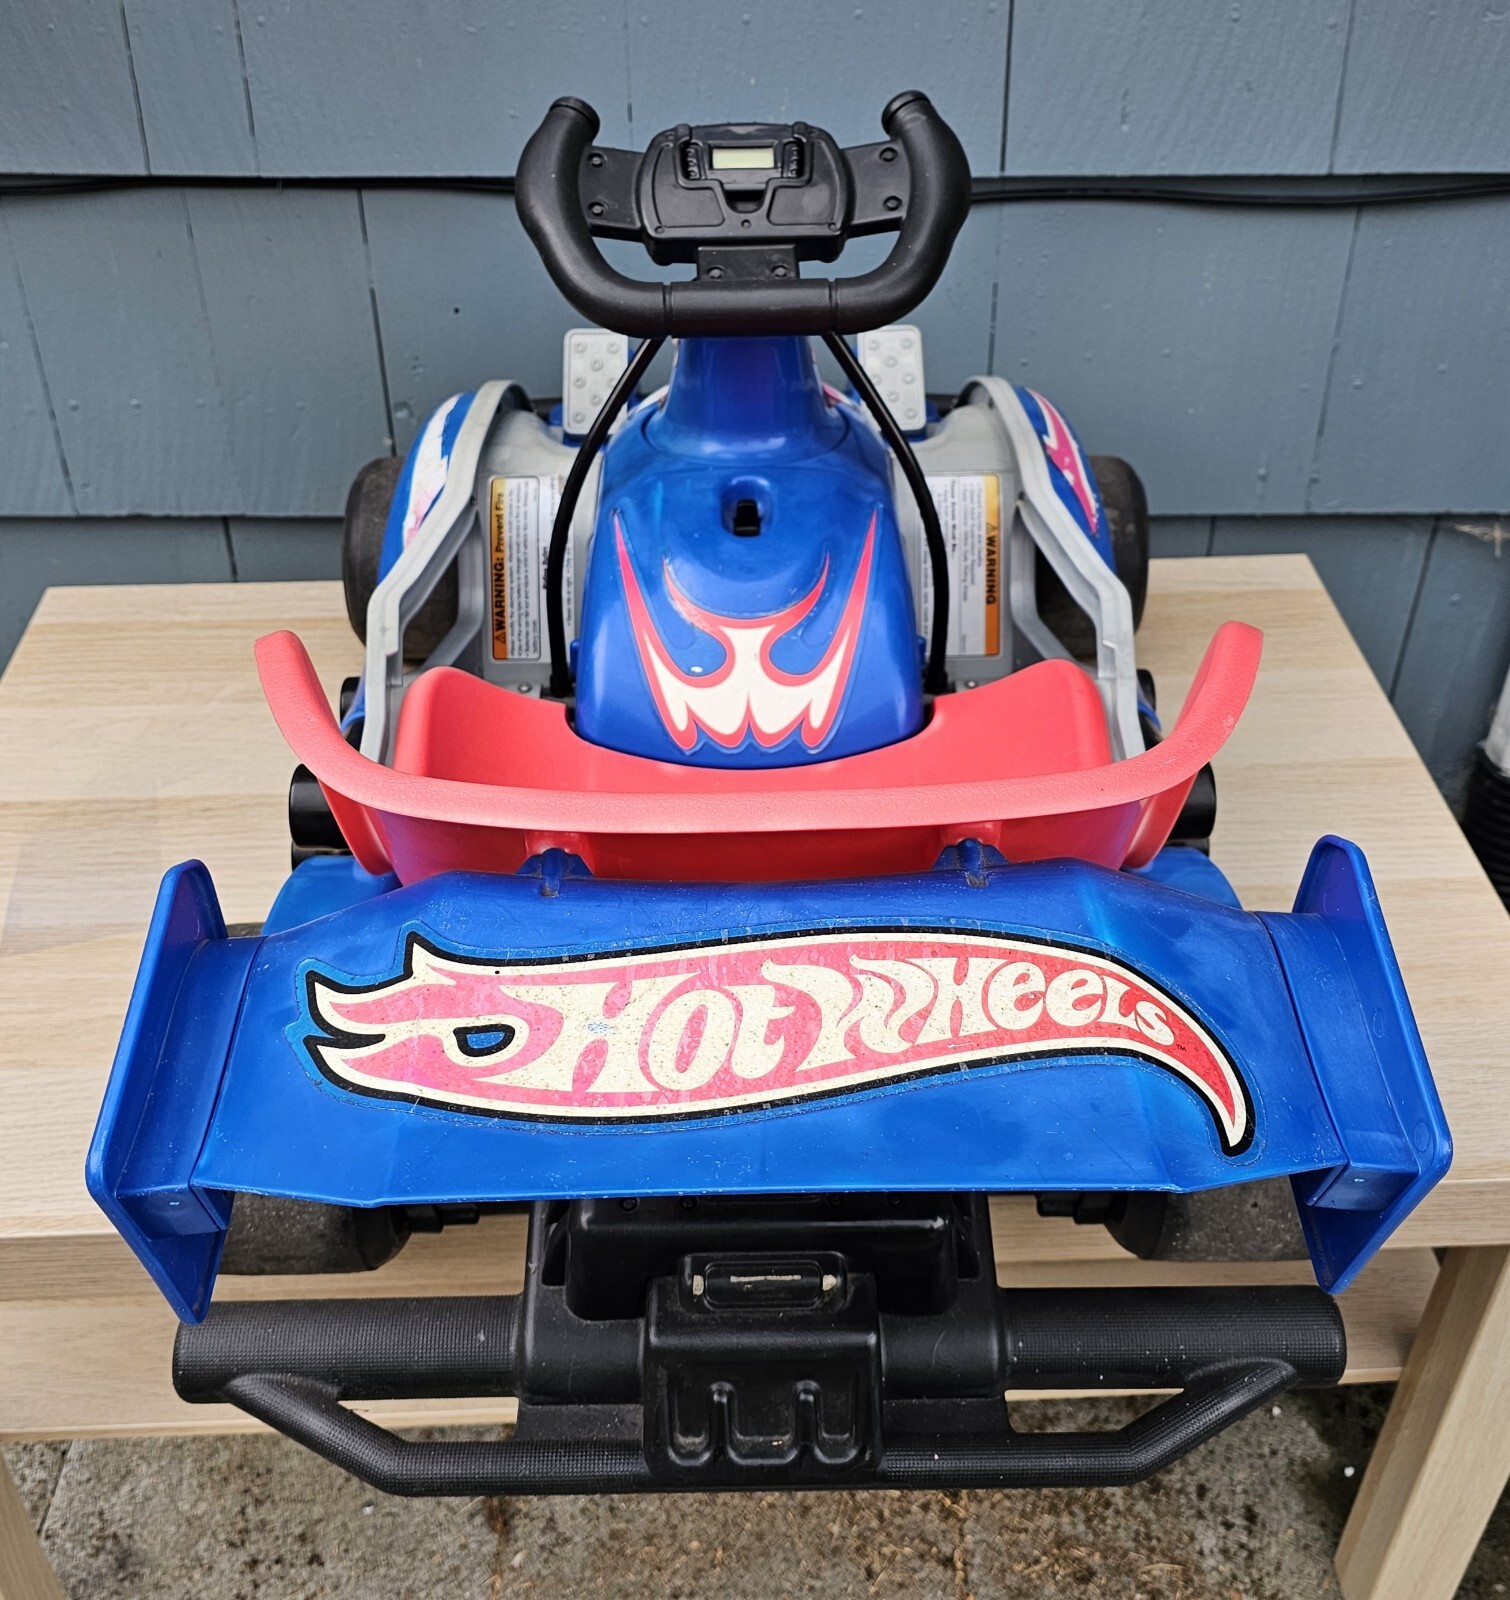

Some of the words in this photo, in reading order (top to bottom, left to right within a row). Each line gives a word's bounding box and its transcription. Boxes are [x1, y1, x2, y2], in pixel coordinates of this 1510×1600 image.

[495, 493, 504, 511] Fire
[495, 514, 504, 552] Prevent
[985, 536, 996, 605] WARNING
[494, 557, 506, 631] WARNING:
[1175, 1043, 1187, 1052] TM
